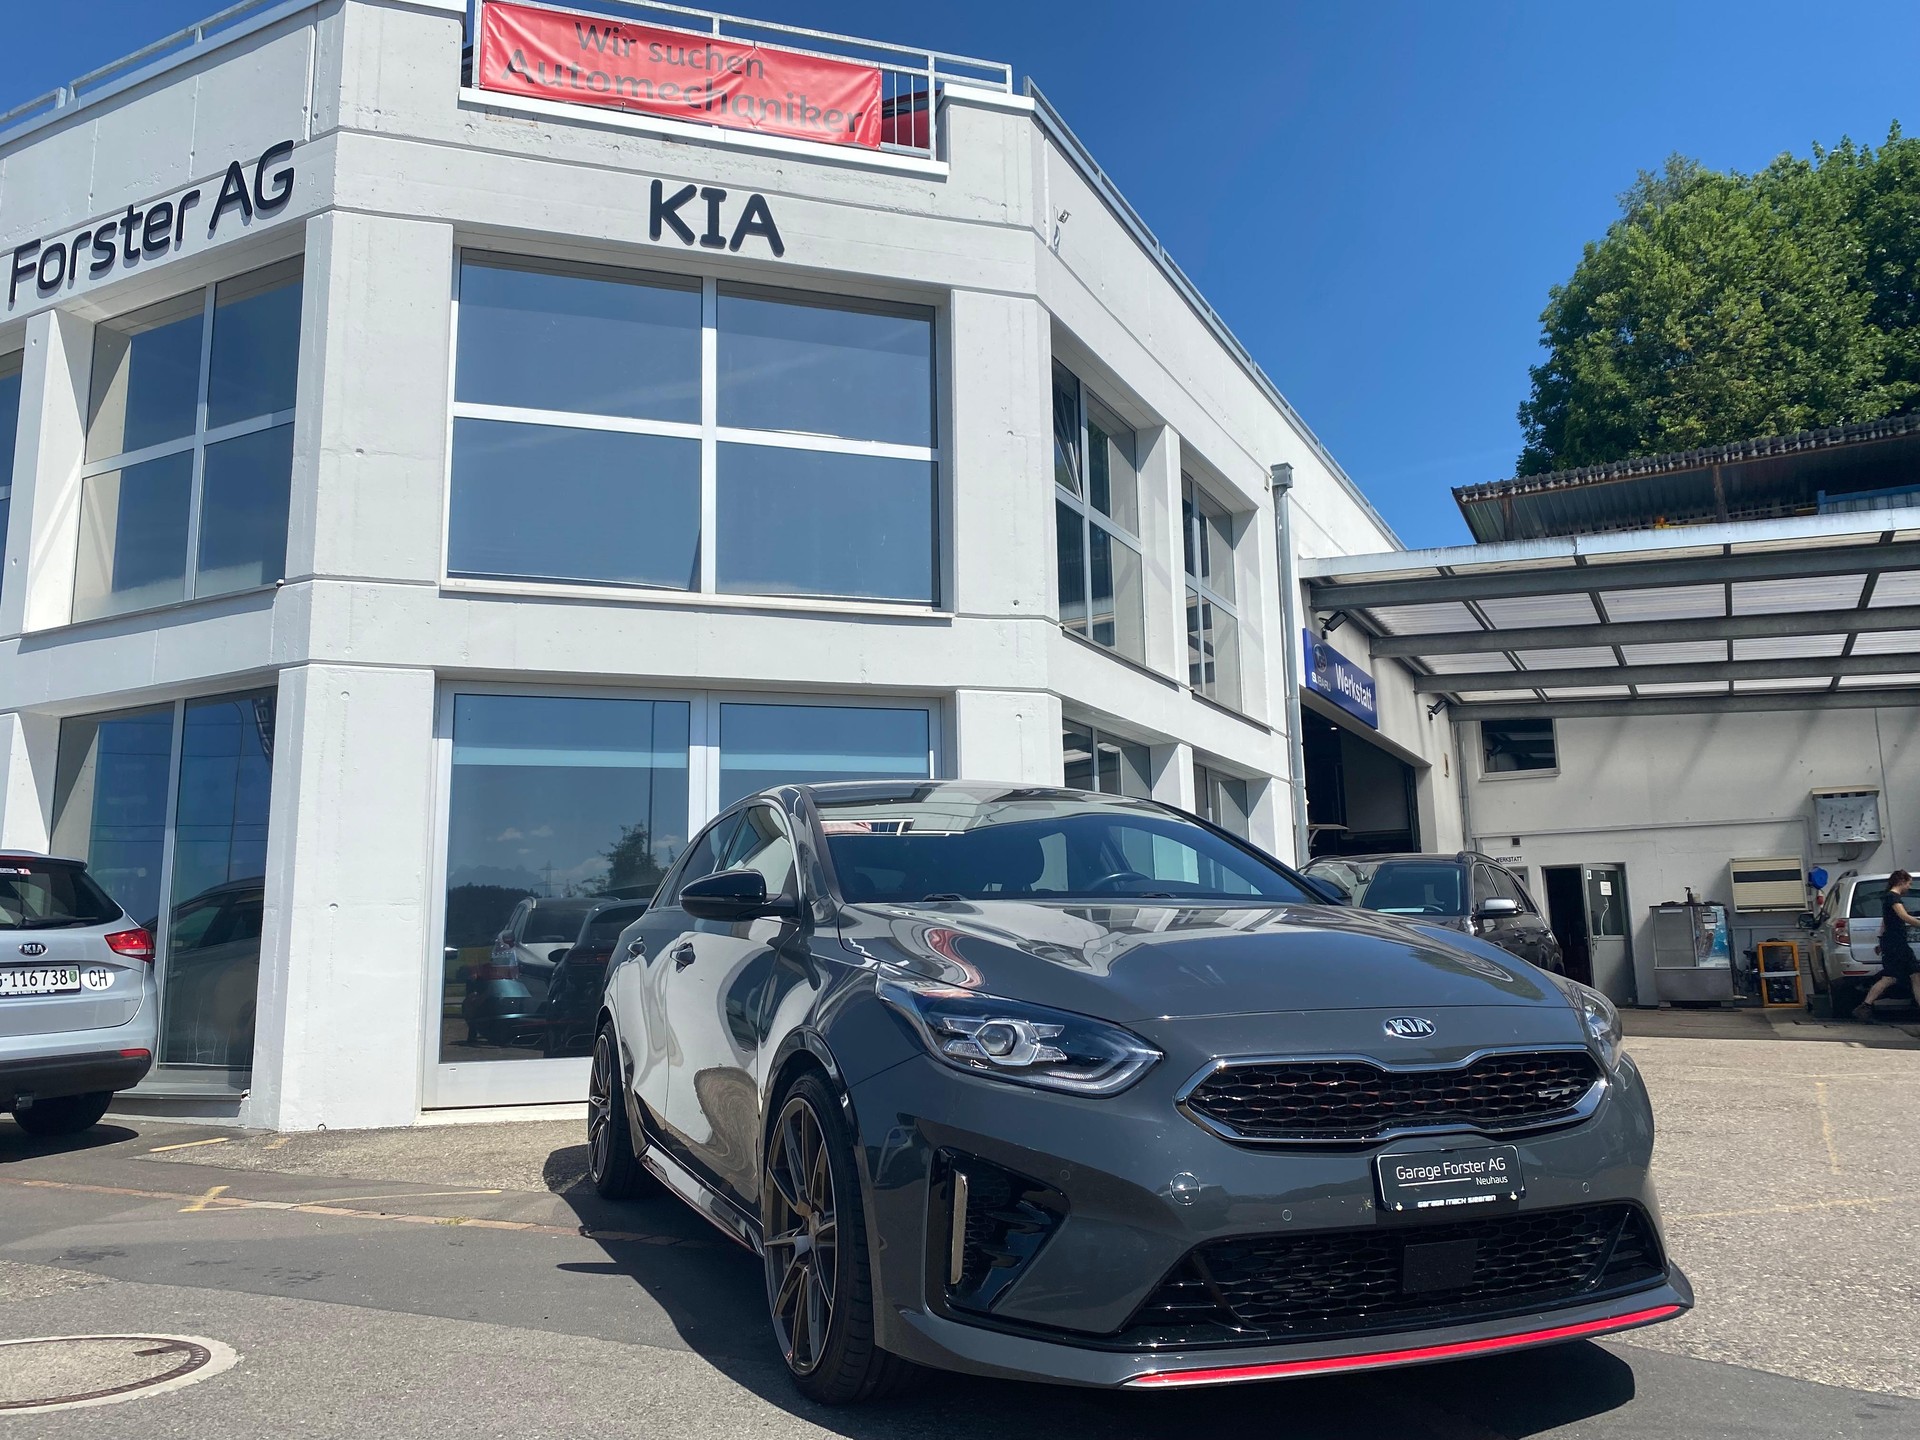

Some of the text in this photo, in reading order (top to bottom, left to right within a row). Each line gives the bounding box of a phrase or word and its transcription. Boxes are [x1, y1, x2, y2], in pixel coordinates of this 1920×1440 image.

[575, 22, 763, 79] Wir suchen
[502, 49, 863, 133] Automechaniker
[9, 140, 295, 307] Forster AG
[650, 178, 785, 258] KIA
[1311, 671, 1332, 692] SUBARU
[1335, 662, 1373, 711] Werkstatt
[24, 944, 44, 954] KIA
[89, 969, 108, 987] CH
[1388, 1018, 1432, 1034] KIA
[1396, 1157, 1506, 1180] Garage Forster AG
[1475, 1175, 1509, 1186] Neuhaus
